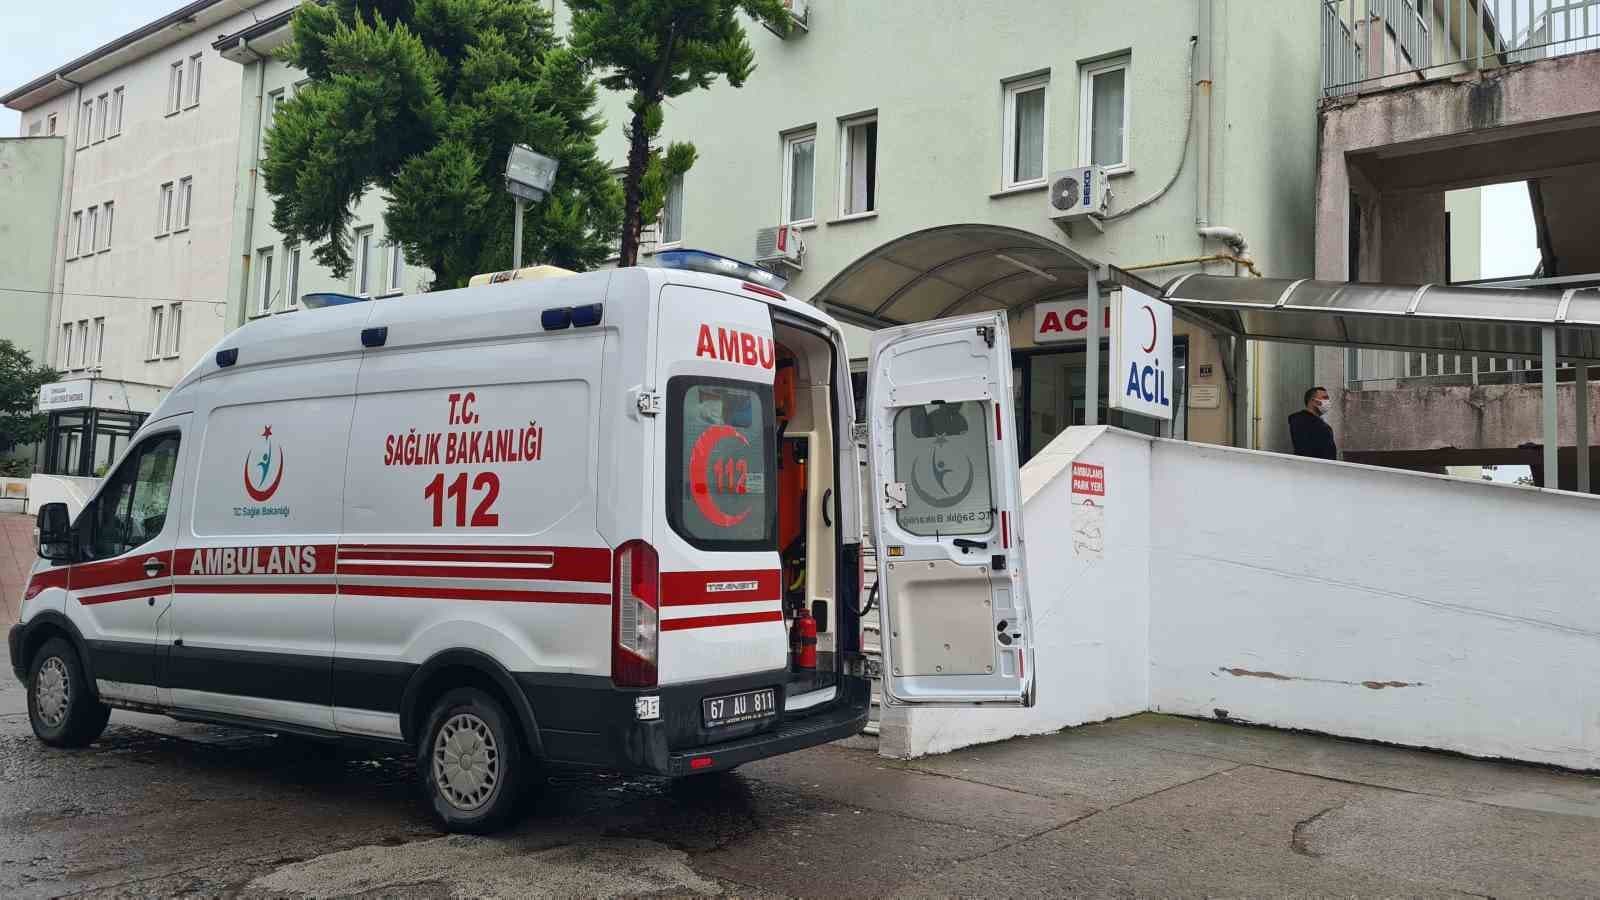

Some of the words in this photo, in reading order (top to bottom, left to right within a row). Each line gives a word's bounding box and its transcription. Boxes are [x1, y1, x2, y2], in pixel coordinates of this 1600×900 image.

[695, 323, 775, 370] AMBU
[1126, 358, 1169, 407] ACİL
[448, 391, 479, 425] T.C.
[384, 428, 442, 466] SAĞLIK
[445, 420, 543, 465] BAKANLIĞI
[713, 456, 749, 496] 112
[424, 471, 500, 528] 112
[190, 545, 316, 575] AMBULANS
[710, 699, 724, 719] 67
[734, 695, 747, 716] AU
[754, 691, 772, 712] 811
